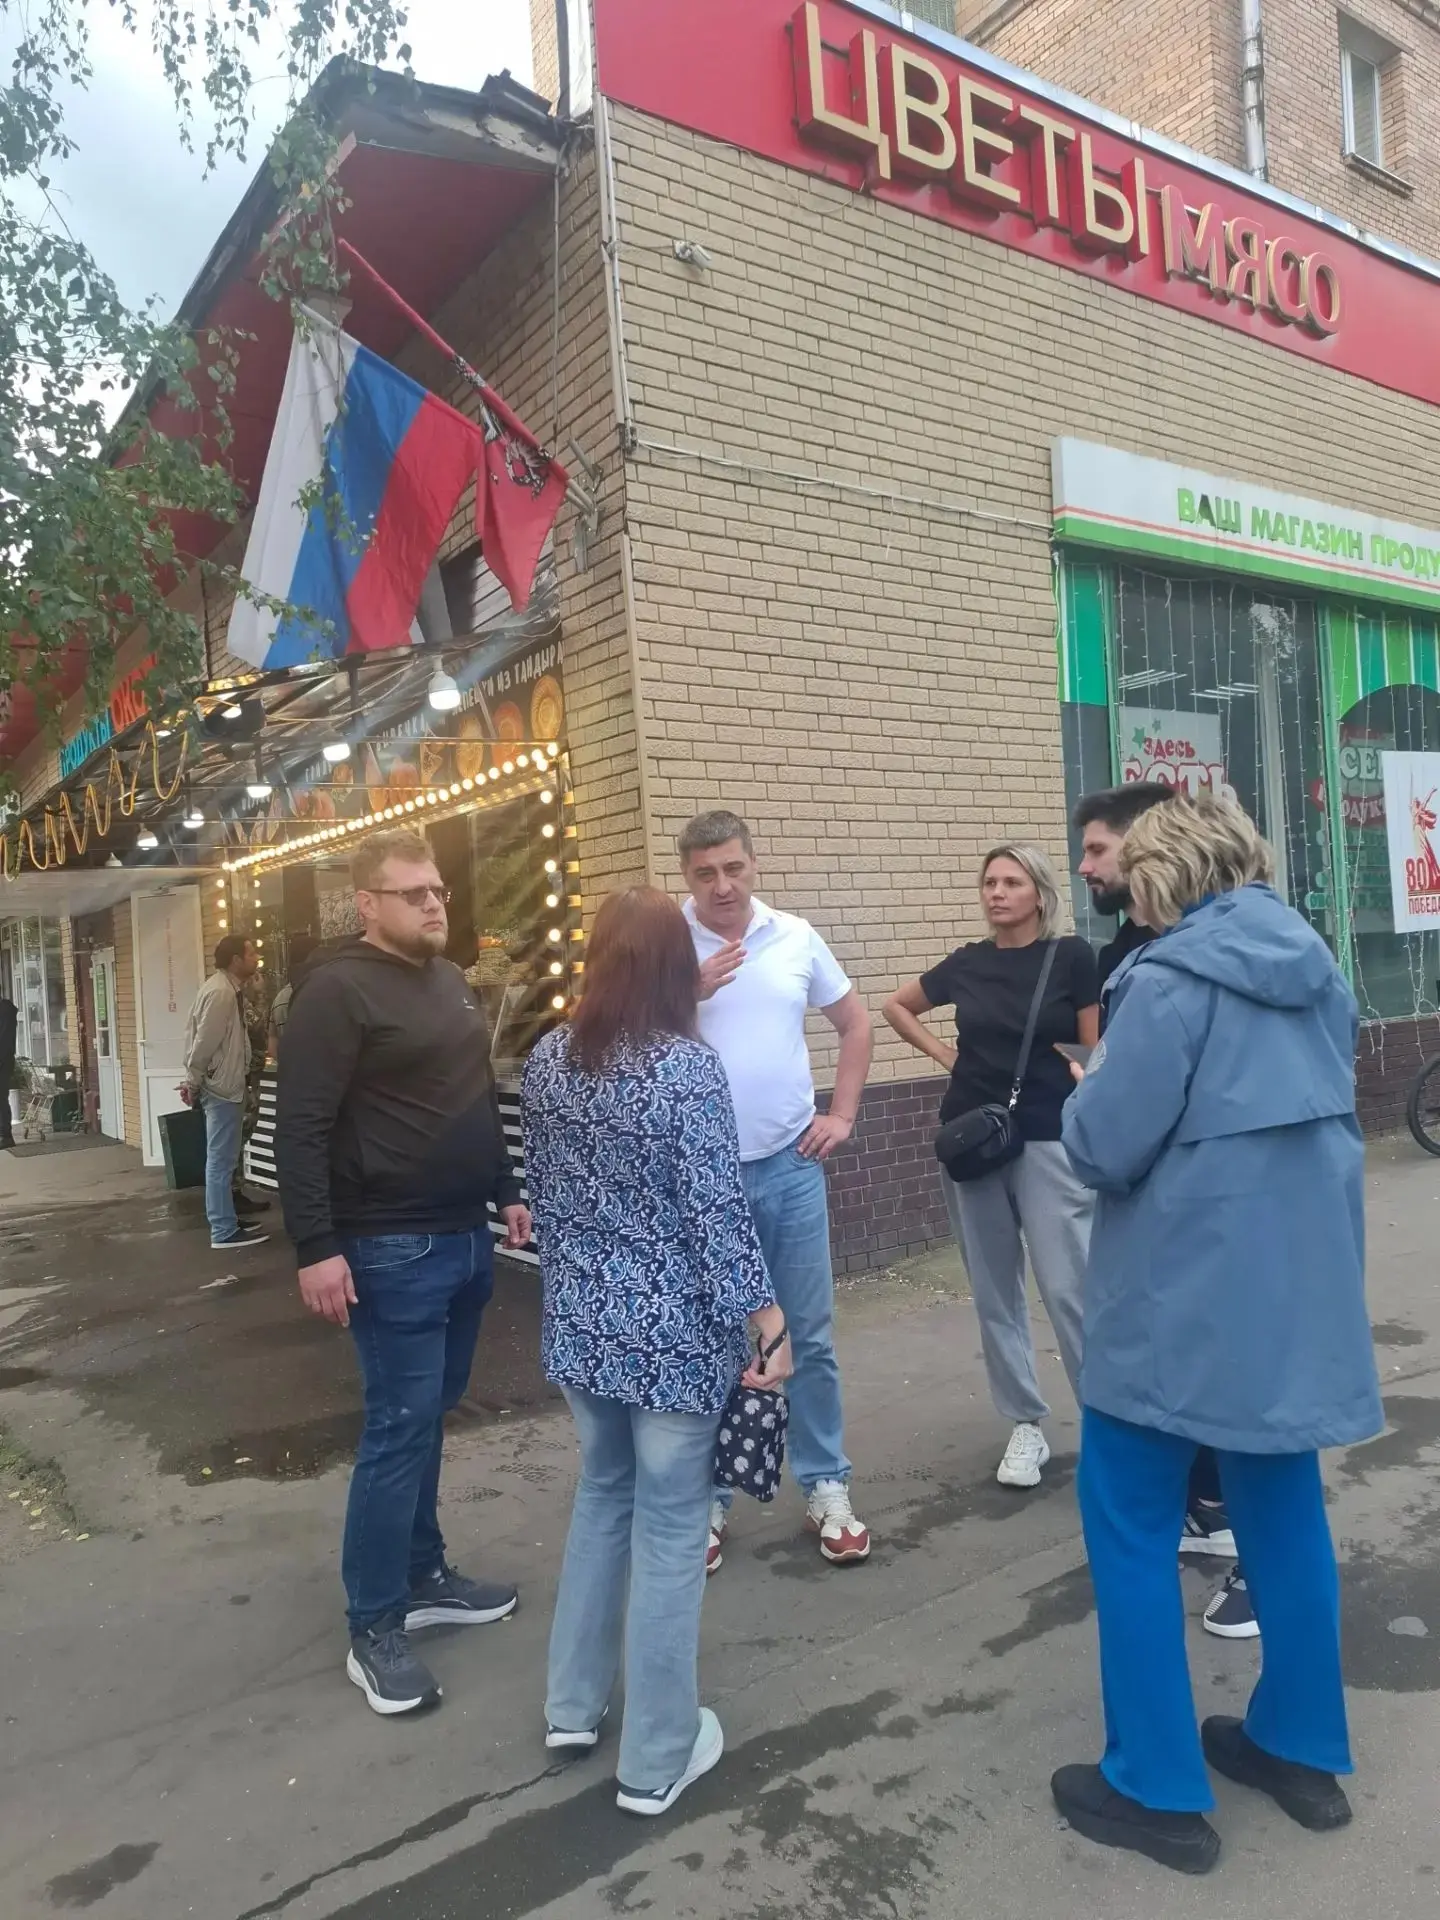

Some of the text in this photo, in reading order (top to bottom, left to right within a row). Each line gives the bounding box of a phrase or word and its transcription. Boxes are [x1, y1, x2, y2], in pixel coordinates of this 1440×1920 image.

[797, 2, 1346, 337] ЦВЕТЫ МЯСО
[1177, 488, 1242, 534] ВАШ
[1251, 506, 1364, 561] МАГАЗИН
[1406, 857, 1430, 890] 80
[1408, 896, 1440, 916] ПОБЕД
